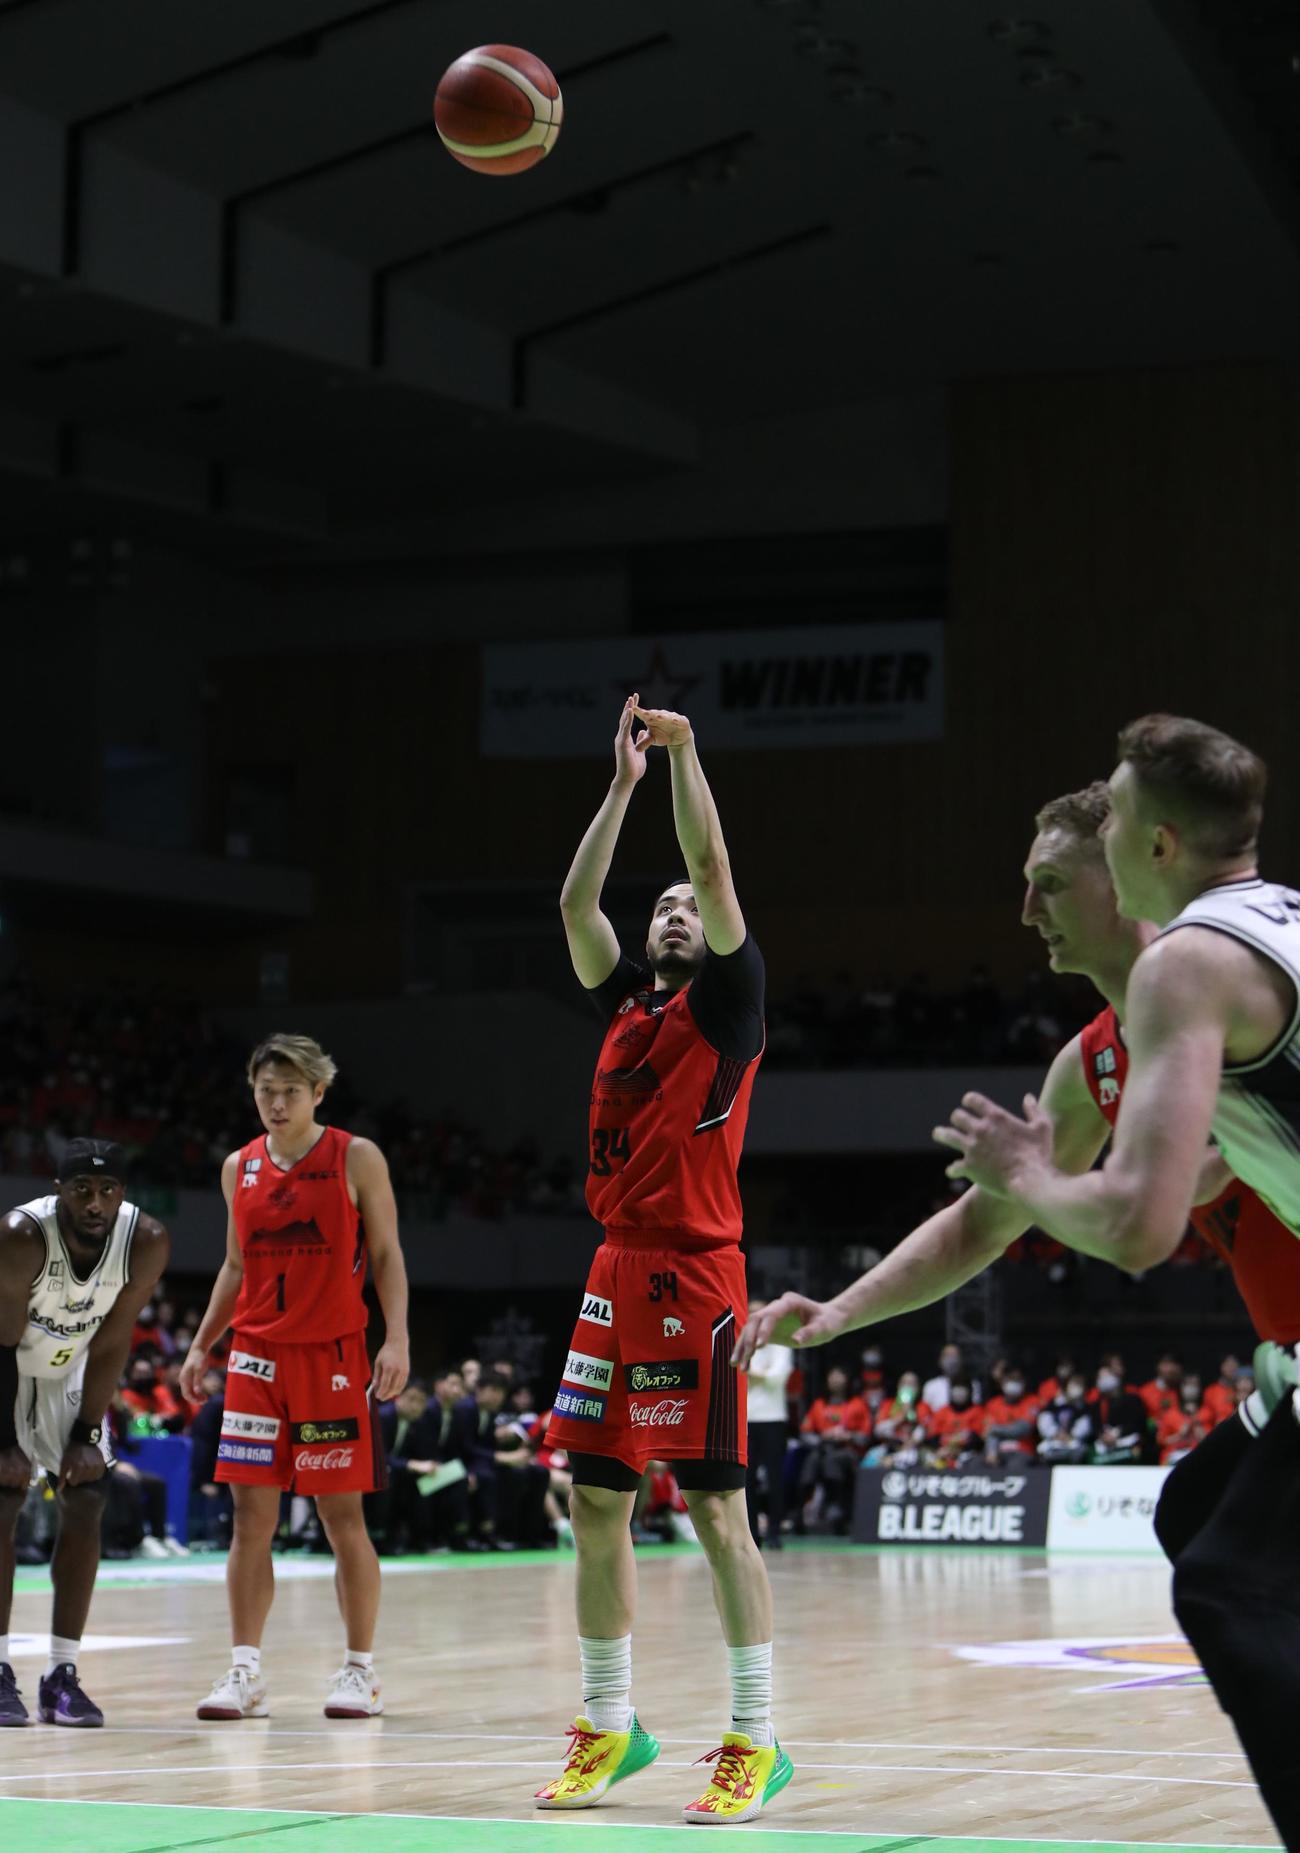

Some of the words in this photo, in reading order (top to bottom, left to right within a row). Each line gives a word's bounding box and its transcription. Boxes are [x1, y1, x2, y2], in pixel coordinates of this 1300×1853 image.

[719, 652, 932, 710] WINNER
[590, 1127, 631, 1176] 34
[276, 1272, 286, 1312] 1
[648, 1271, 679, 1303] 34
[581, 1299, 612, 1322] JAL
[50, 1347, 74, 1367] 5
[238, 1360, 272, 1378] JAL
[646, 1374, 681, 1387] レオファン
[294, 1447, 354, 1472] Coca-Cola
[908, 1475, 1026, 1498] りそなグループ
[877, 1503, 1025, 1541] B.LEAGUE
